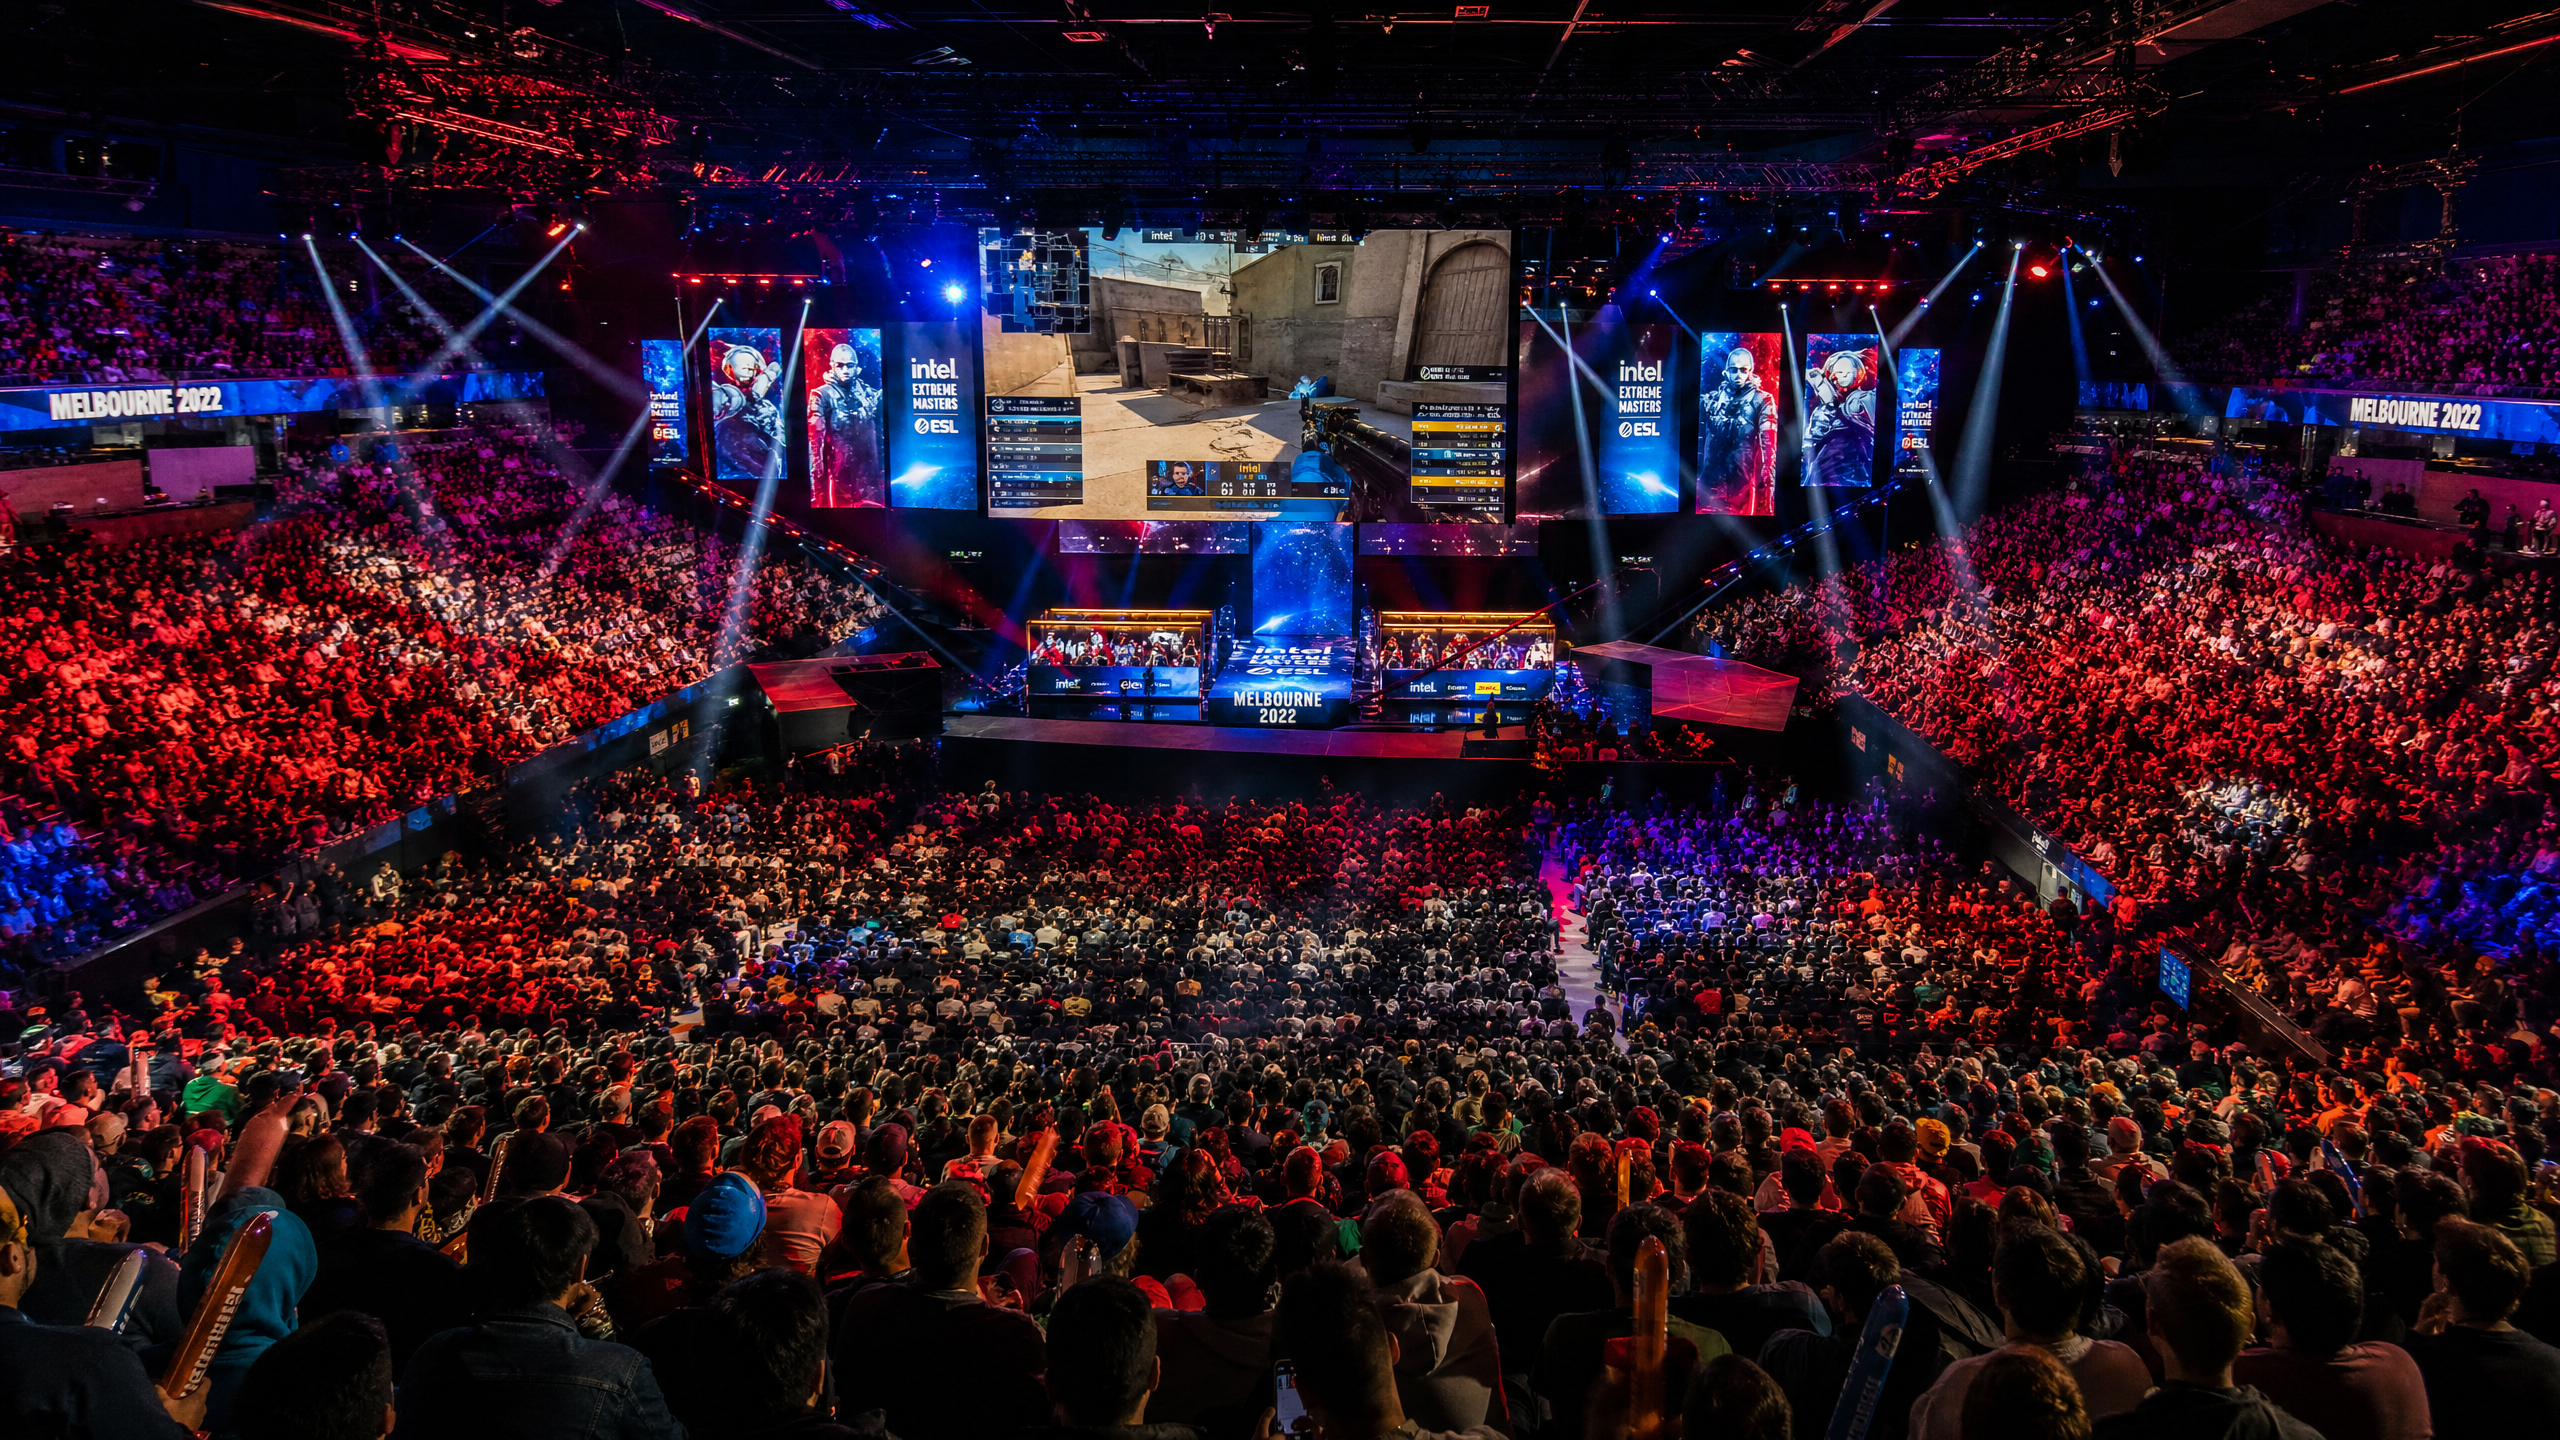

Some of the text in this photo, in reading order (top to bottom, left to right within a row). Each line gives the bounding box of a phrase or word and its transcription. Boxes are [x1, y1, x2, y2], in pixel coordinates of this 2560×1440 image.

[912, 383, 958, 396] EXTREME
[1619, 386, 1662, 399] EXTREME
[49, 387, 223, 420] MELBOURNE 2022
[913, 397, 958, 410] MASTERS
[1618, 400, 1662, 413] MASTERS
[2350, 398, 2482, 431] MELBOURNE 2022
[930, 419, 959, 434] ESL
[1634, 422, 1660, 436] ESL
[1233, 691, 1323, 707] MELBOURNE
[1259, 708, 1297, 723] 2022
